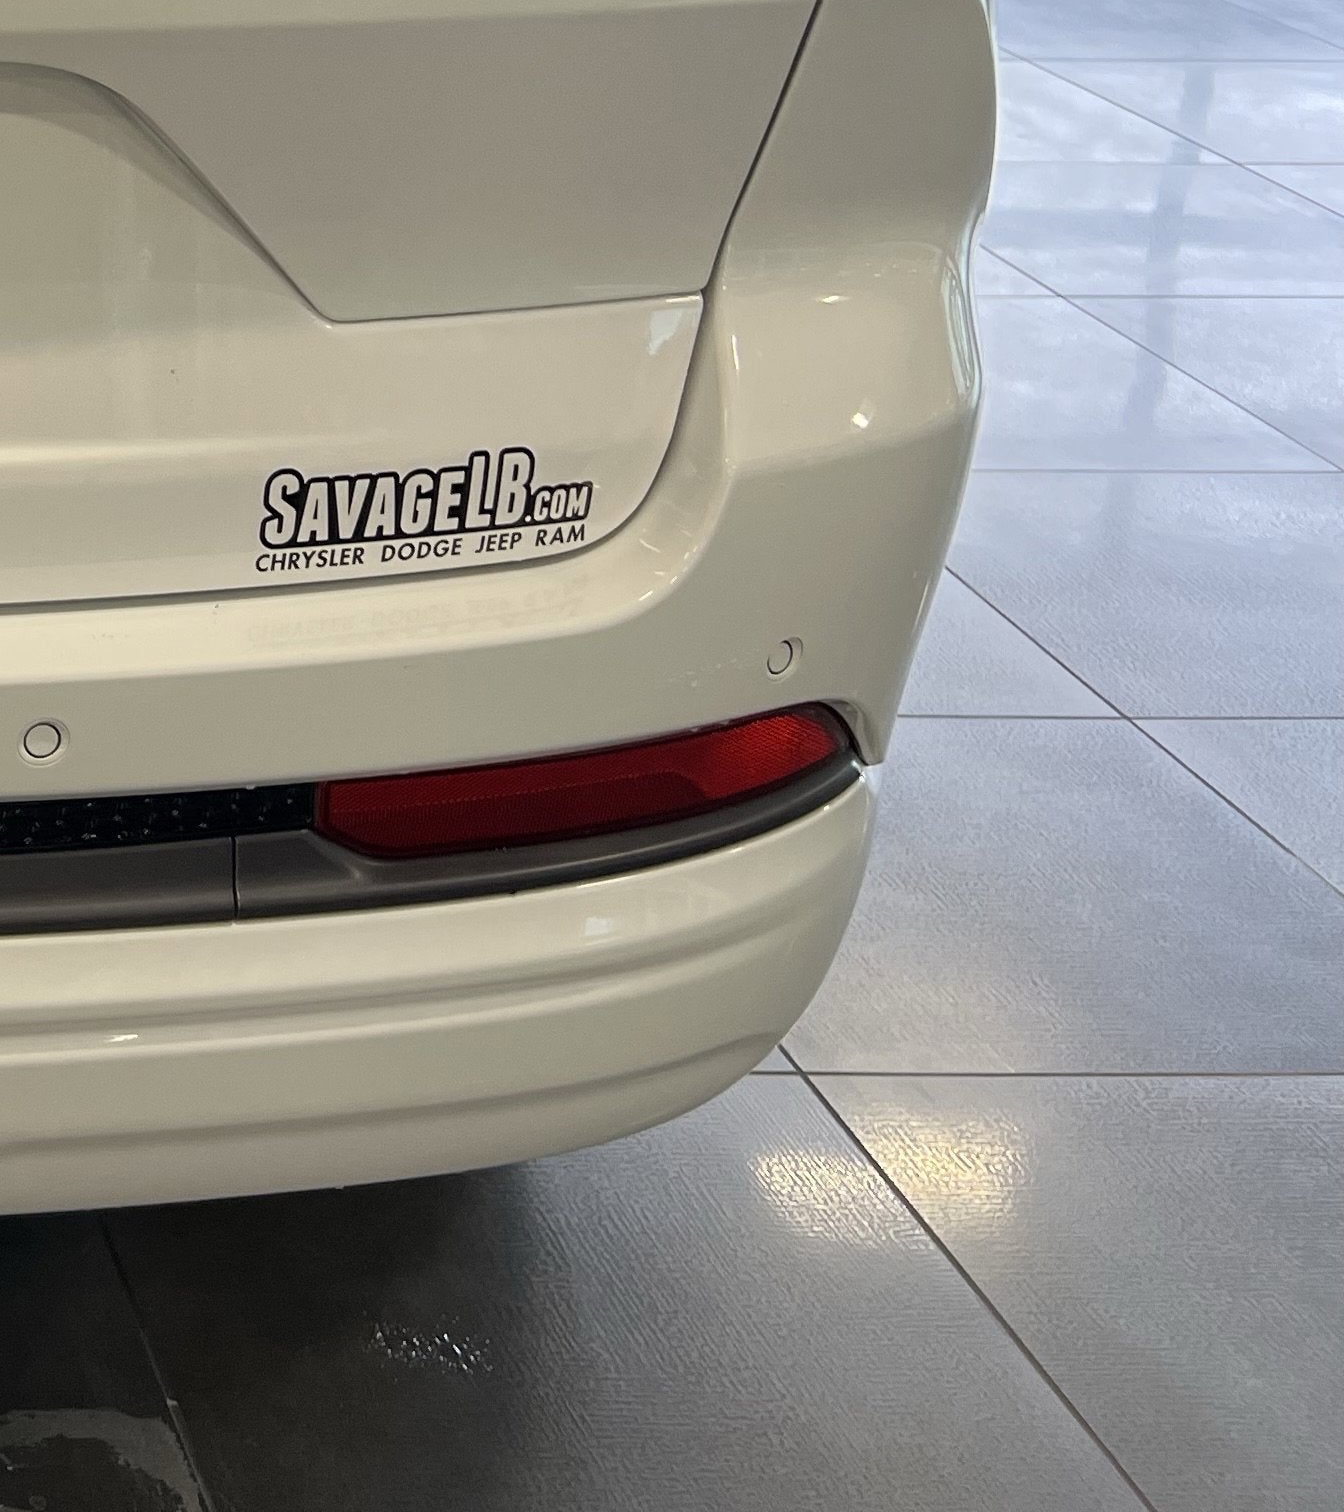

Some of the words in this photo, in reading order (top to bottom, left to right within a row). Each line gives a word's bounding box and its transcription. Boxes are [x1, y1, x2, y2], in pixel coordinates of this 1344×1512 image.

[255, 546, 365, 572] CHRYSLER
[380, 537, 464, 563] DODGE
[474, 531, 523, 554] JEEP
[534, 523, 586, 547] RAM
